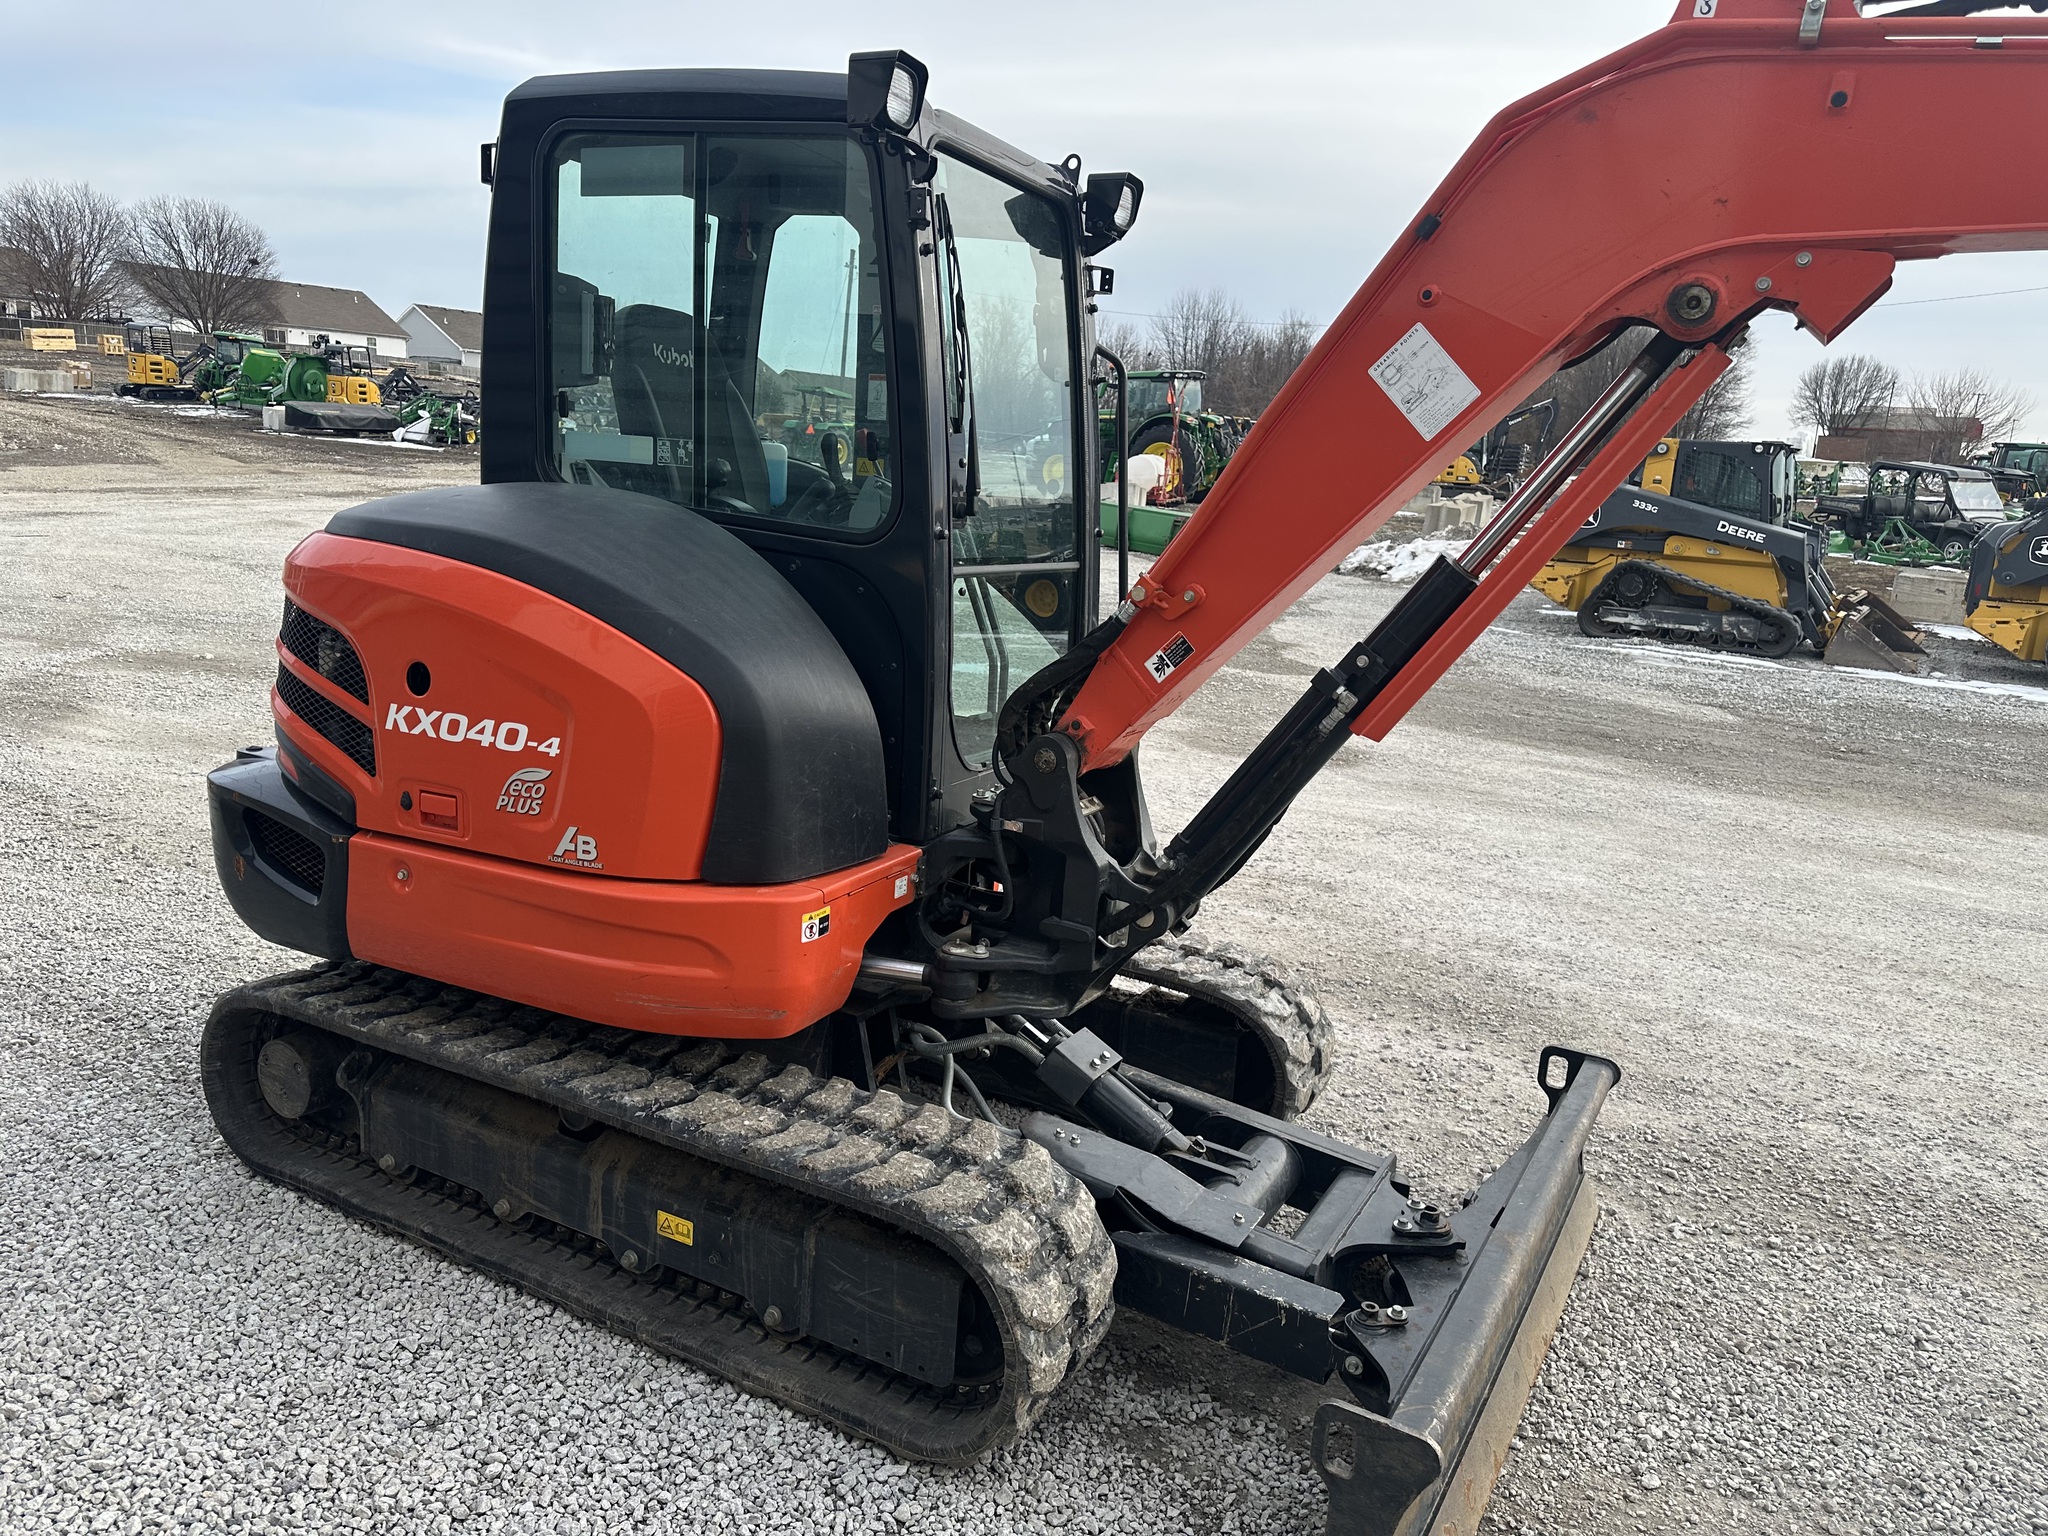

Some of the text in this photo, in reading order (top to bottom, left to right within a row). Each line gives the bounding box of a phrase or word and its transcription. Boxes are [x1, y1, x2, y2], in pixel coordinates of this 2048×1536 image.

[653, 343, 693, 367] Kubot
[1373, 328, 1419, 372] GREASING POINTS
[1632, 499, 1659, 514] 333G
[1716, 520, 1767, 544] DEERE
[385, 703, 561, 757] KX040-4
[509, 780, 546, 799] eco
[495, 795, 543, 816] PLUS
[553, 826, 599, 861] AB
[564, 858, 583, 866] ANGLE
[583, 861, 603, 869] BLADE
